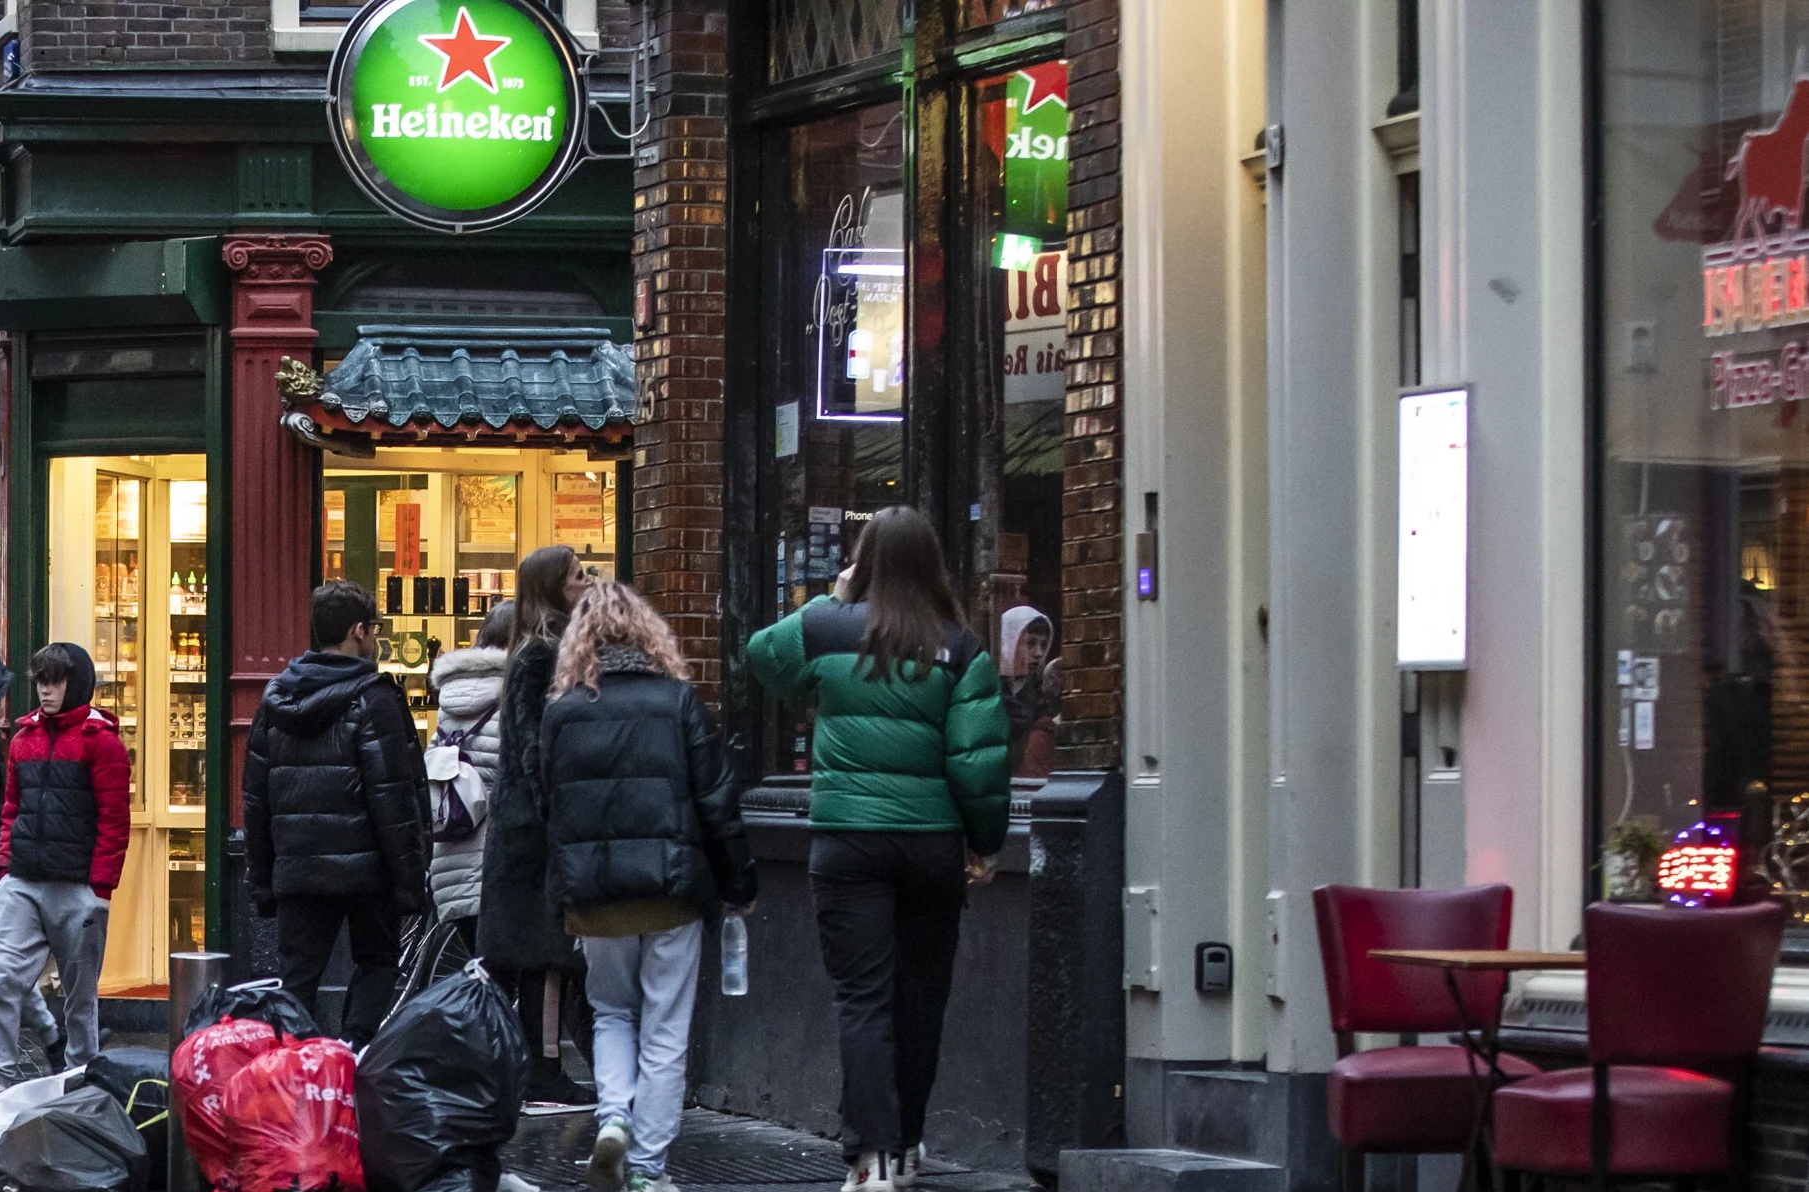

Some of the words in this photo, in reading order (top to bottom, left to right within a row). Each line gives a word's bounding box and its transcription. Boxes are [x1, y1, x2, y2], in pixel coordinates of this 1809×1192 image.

[371, 103, 554, 142] Heineken
[872, 282, 904, 293] PERFEC
[844, 510, 874, 521] Phone
